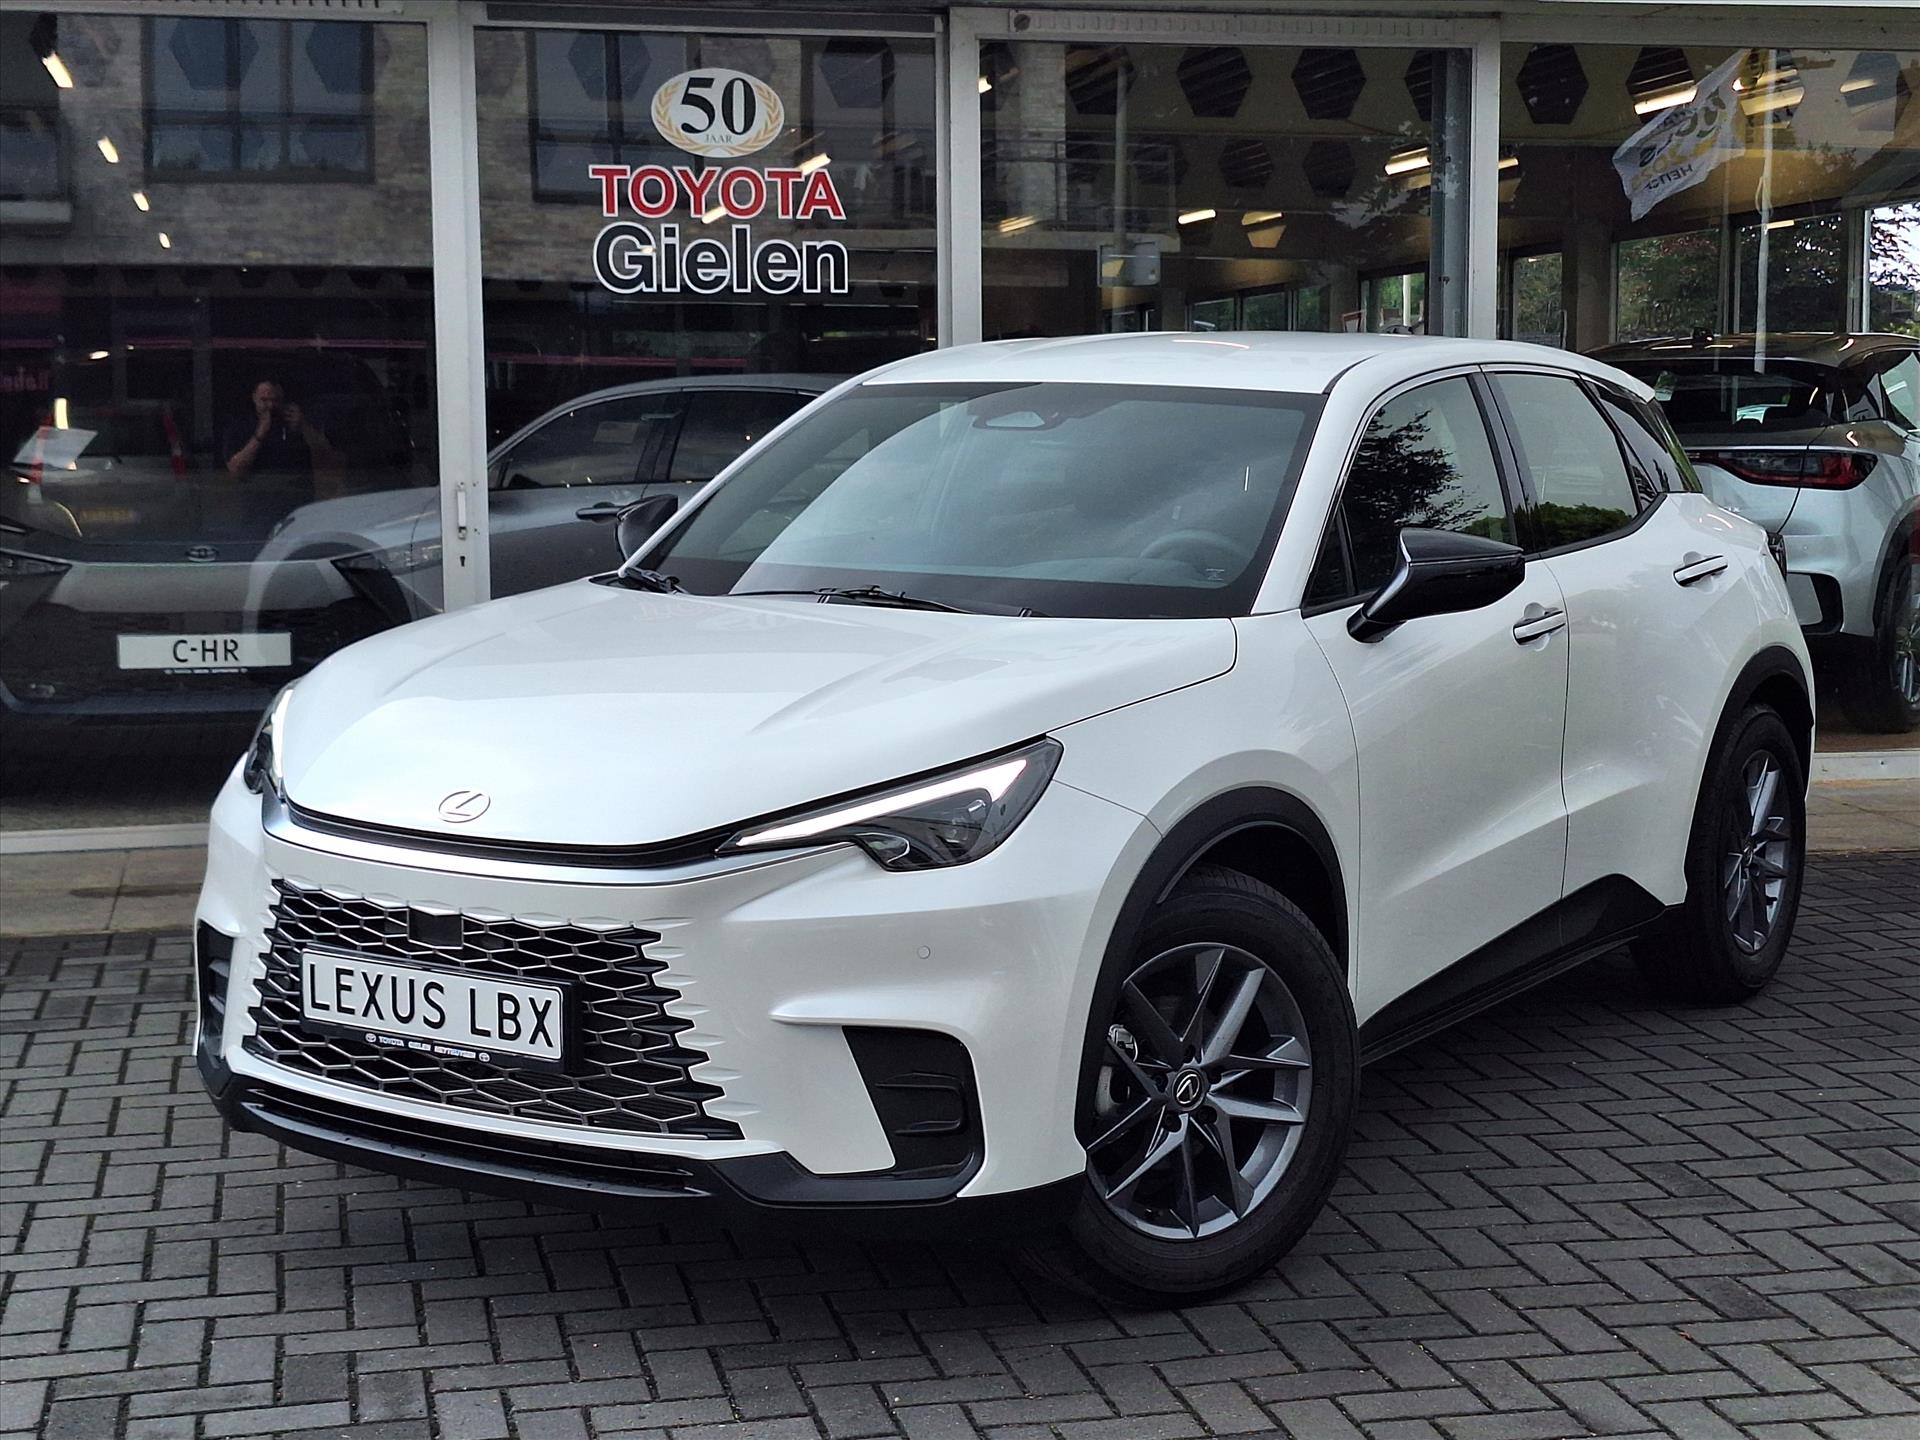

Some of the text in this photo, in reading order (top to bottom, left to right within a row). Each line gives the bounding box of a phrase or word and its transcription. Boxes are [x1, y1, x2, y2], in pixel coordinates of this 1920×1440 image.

[680, 77, 756, 135] 50
[704, 133, 734, 144] JAAR
[588, 164, 846, 220] TOYOTA
[593, 221, 848, 294] Gielen
[173, 639, 239, 663] C-HR
[309, 963, 554, 1048] LEXUS LBX
